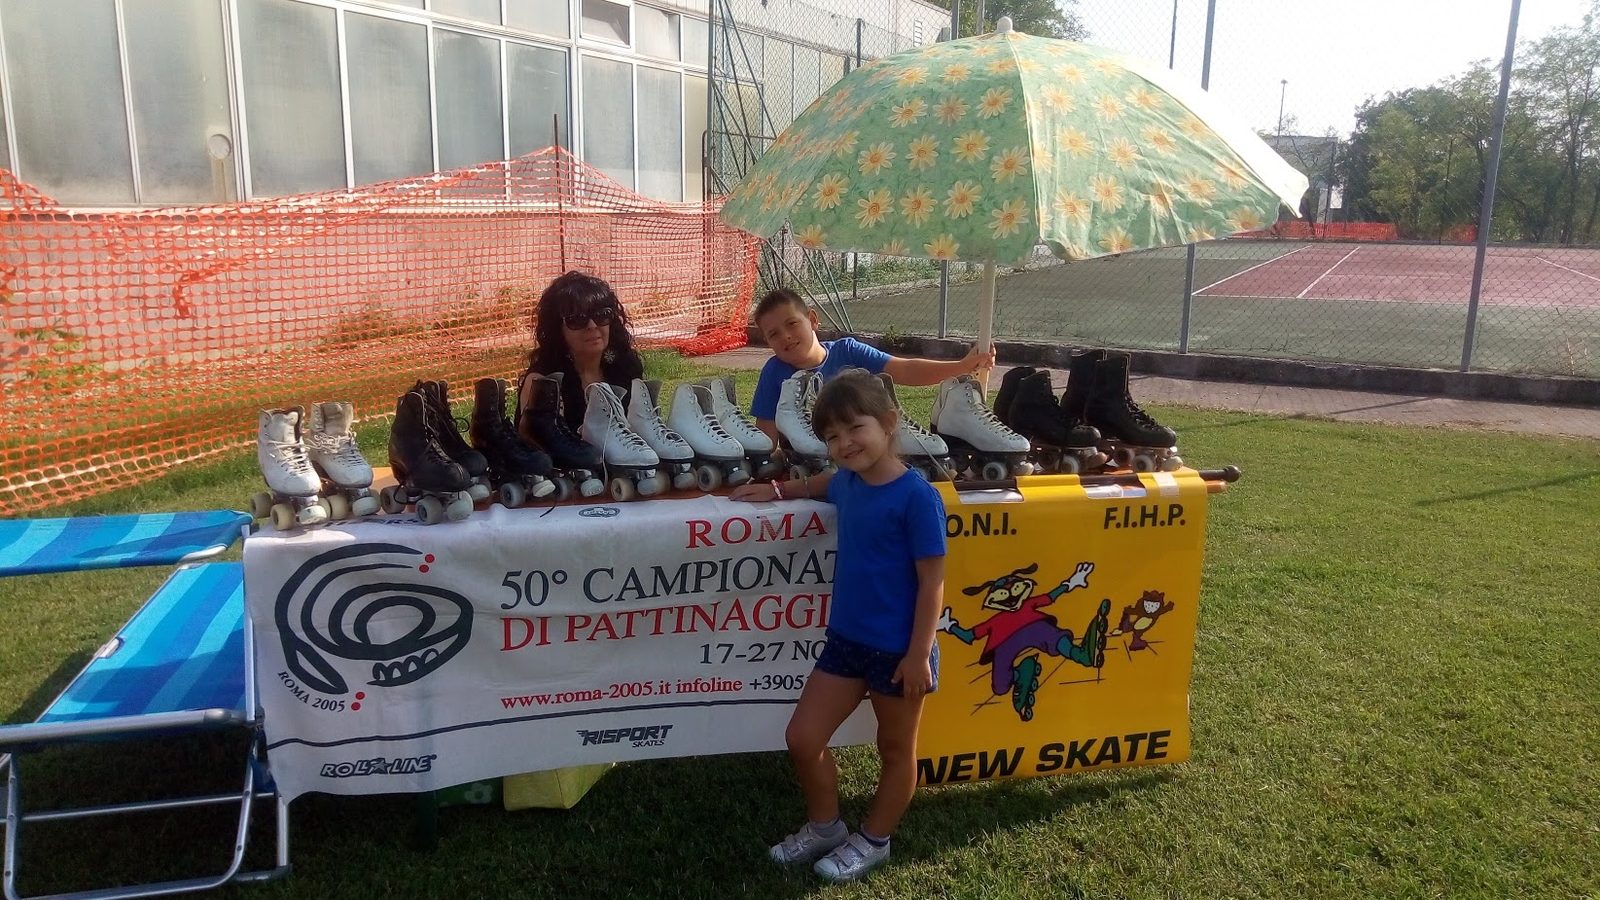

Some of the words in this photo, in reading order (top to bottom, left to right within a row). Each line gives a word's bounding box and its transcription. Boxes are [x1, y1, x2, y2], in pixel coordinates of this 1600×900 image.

[685, 511, 829, 549] ROMA
[946, 512, 1017, 537] O.N.I.
[1103, 503, 1187, 530] F.I.H.P.
[500, 569, 568, 610] 50°
[500, 616, 553, 651] DI
[564, 593, 832, 643] PATTINAGGI
[700, 641, 785, 664] 17-27
[791, 640, 827, 661] NO
[278, 671, 309, 704] ROMA
[312, 698, 346, 713] 2005
[501, 680, 672, 709] www.roma-2005.it
[675, 677, 743, 696] infoline
[750, 674, 809, 691] +3905
[576, 724, 674, 747] RISPORT
[632, 740, 665, 748] SKATES
[916, 747, 1025, 786] NEW
[1036, 730, 1171, 771] SKATE
